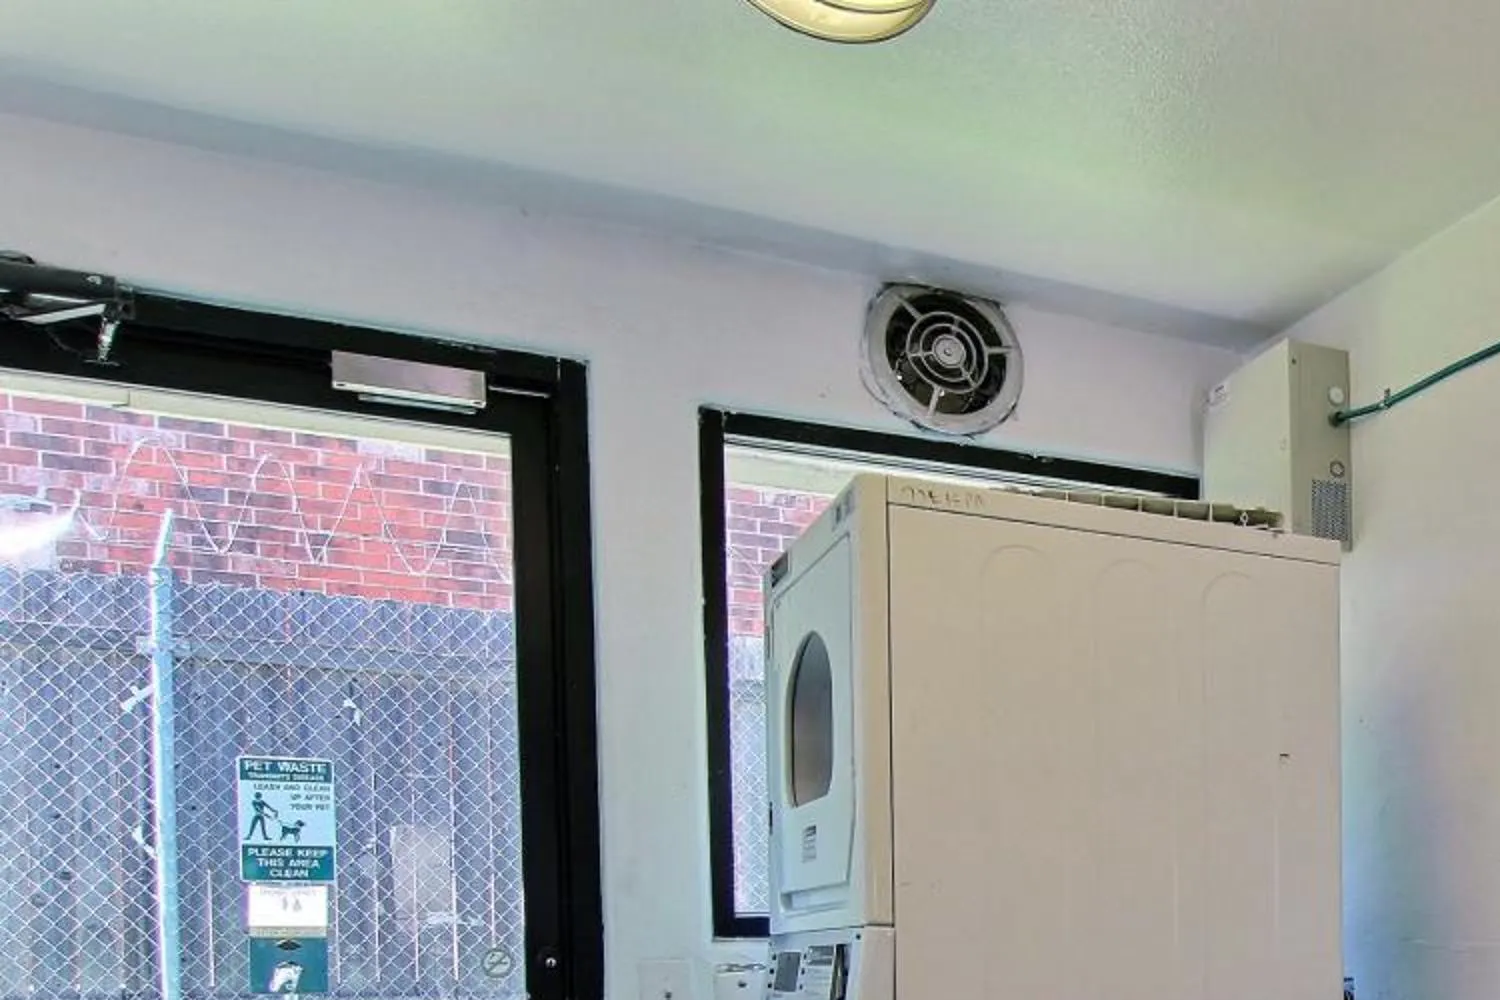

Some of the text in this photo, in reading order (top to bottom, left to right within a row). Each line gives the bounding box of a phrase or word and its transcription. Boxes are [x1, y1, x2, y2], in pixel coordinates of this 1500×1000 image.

[245, 760, 327, 774] PET WASTE
[247, 847, 329, 859] PLEASE KEEP
[256, 857, 321, 869] THIS AREA
[269, 868, 309, 878] CLEAN
